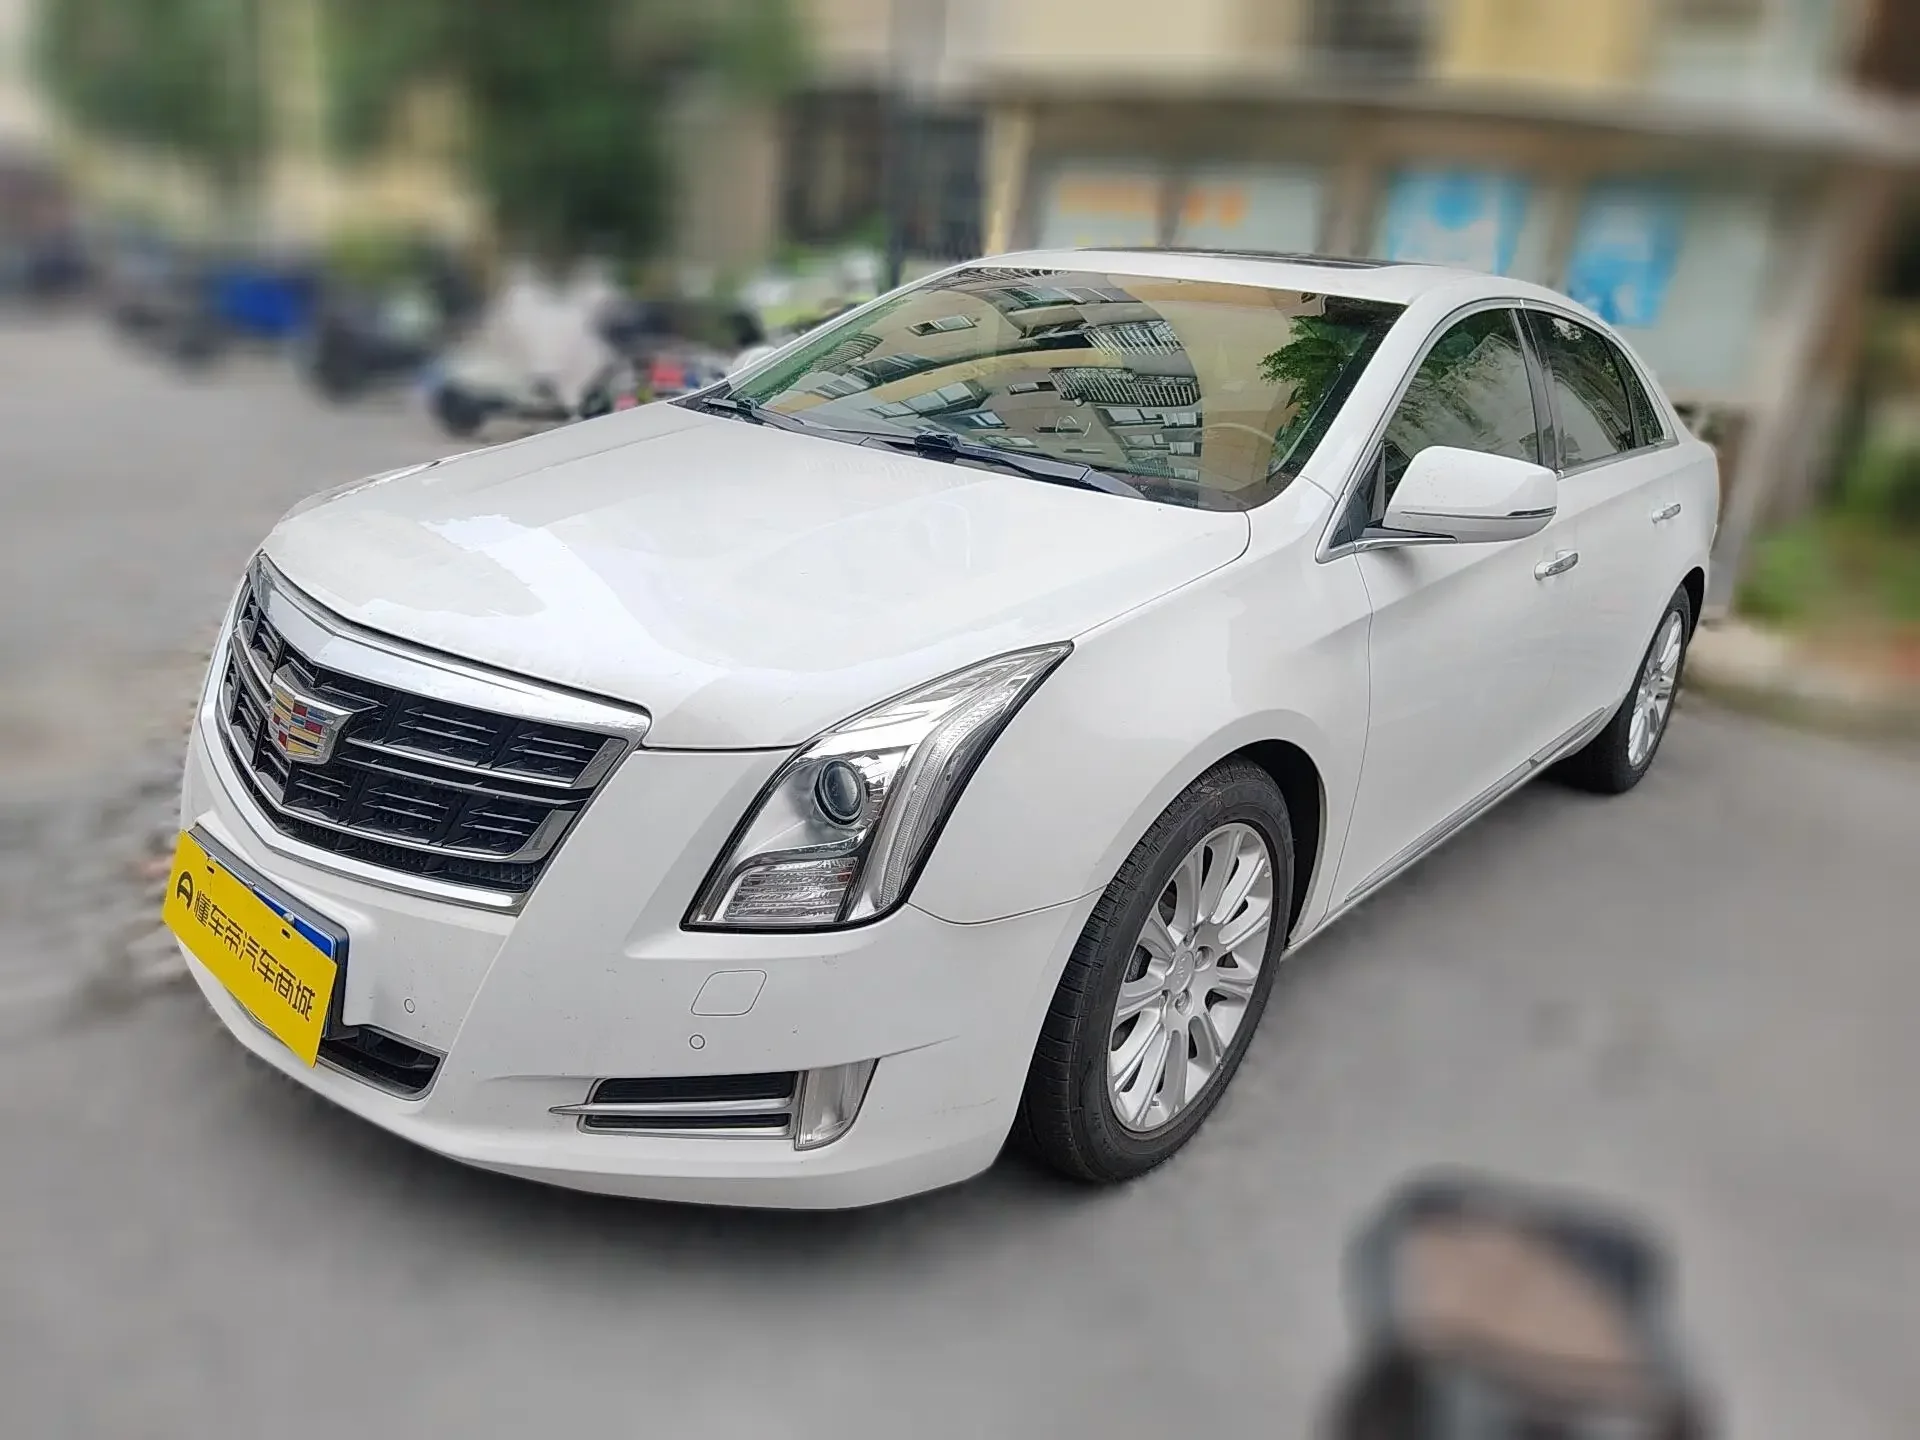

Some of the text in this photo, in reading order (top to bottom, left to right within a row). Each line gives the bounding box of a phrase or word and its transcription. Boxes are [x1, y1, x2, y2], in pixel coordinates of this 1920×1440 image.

[194, 890, 316, 1022] 懂车帝汽车商城
